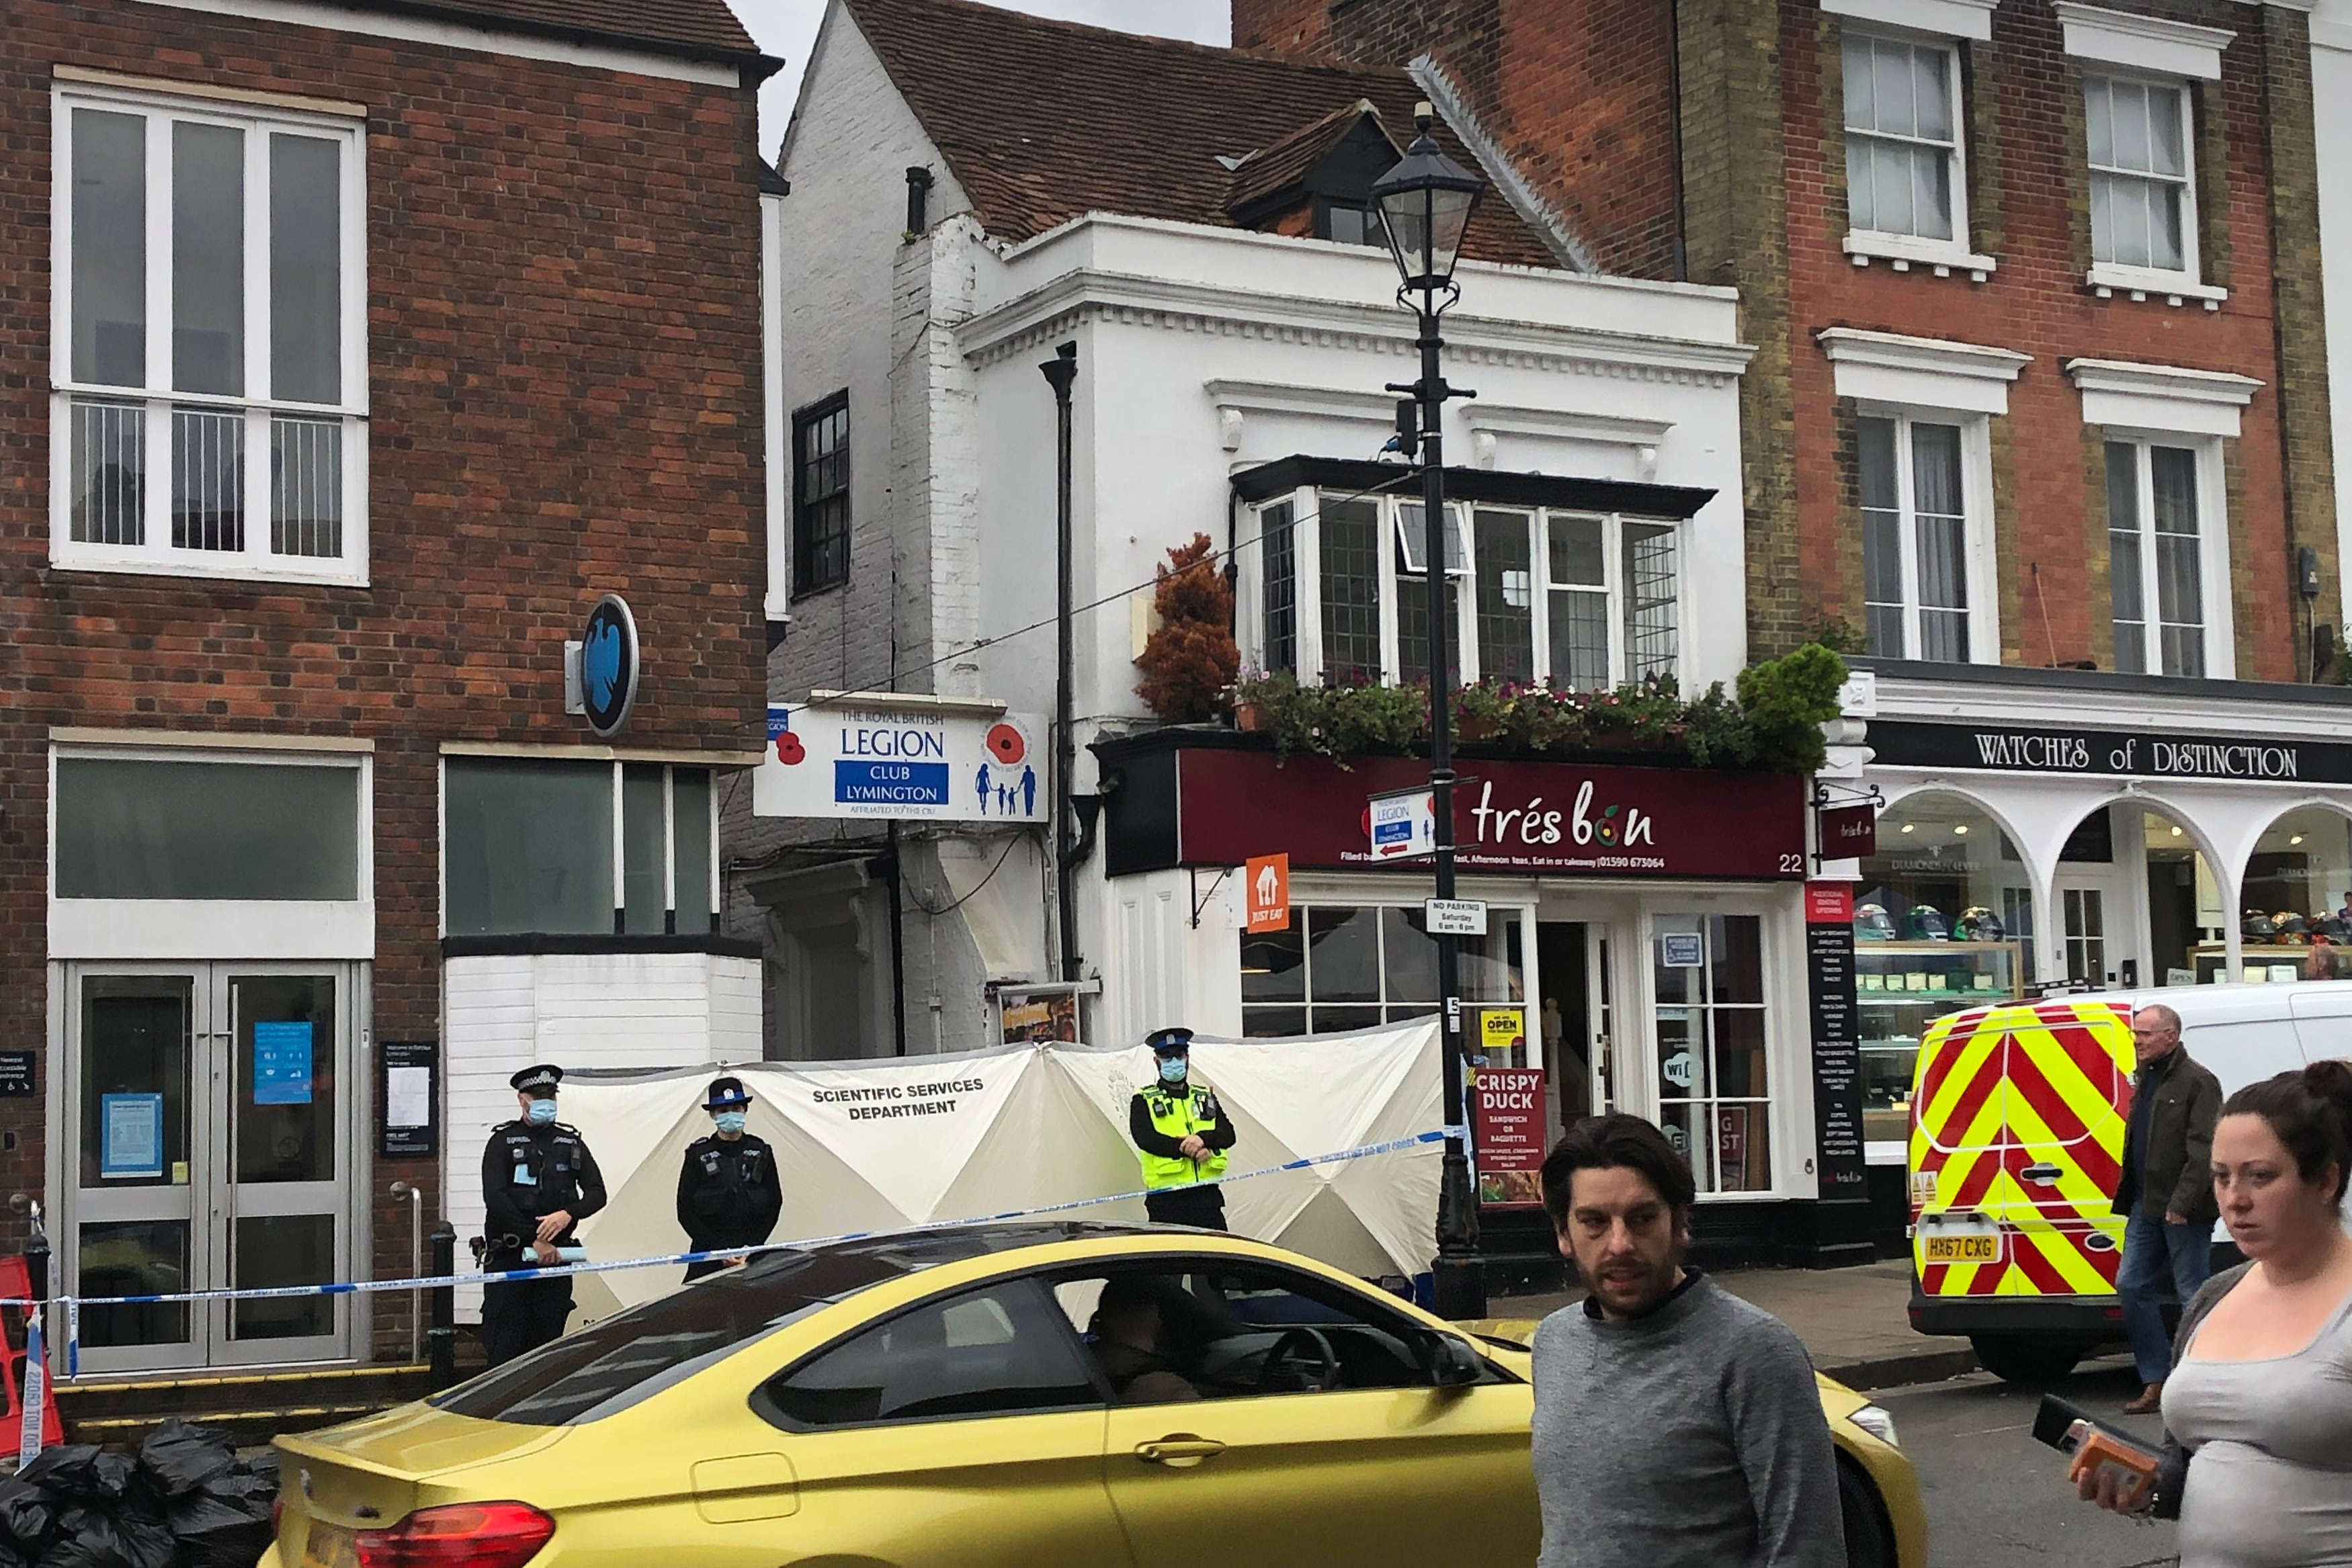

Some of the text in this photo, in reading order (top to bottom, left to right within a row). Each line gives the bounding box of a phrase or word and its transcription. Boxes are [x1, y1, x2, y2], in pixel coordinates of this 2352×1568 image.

[841, 711, 944, 726] THE ROYAL BRITISH
[841, 728, 943, 758] LEGION
[1974, 734, 2298, 778] WATCHES of DISTINCTION
[870, 765, 911, 781] CLUB
[846, 785, 937, 801] LYMINGTON
[1378, 806, 1410, 822] LEGION
[1341, 852, 1362, 861] Filled
[1532, 857, 1546, 865] Eat
[1546, 857, 1554, 865] in
[1630, 857, 1665, 868] 673064
[1779, 854, 1802, 873] 22
[1447, 903, 1480, 911] PARKING
[1251, 908, 1284, 924] JUST EAT
[1441, 913, 1472, 922] Saturday
[1452, 1000, 1458, 1011] 5
[1487, 1020, 1517, 1029] OPEN
[812, 1078, 984, 1104] SCIENTIFIC SERVICES
[1475, 1074, 1540, 1092] CRISPY
[1482, 1092, 1534, 1110] DUCK
[848, 1100, 958, 1121] DEPARTMENT
[1488, 1115, 1528, 1123] SANDWICH
[1490, 1135, 1527, 1143] BAGUETTE
[1929, 1237, 1991, 1257] HX67 CXG
